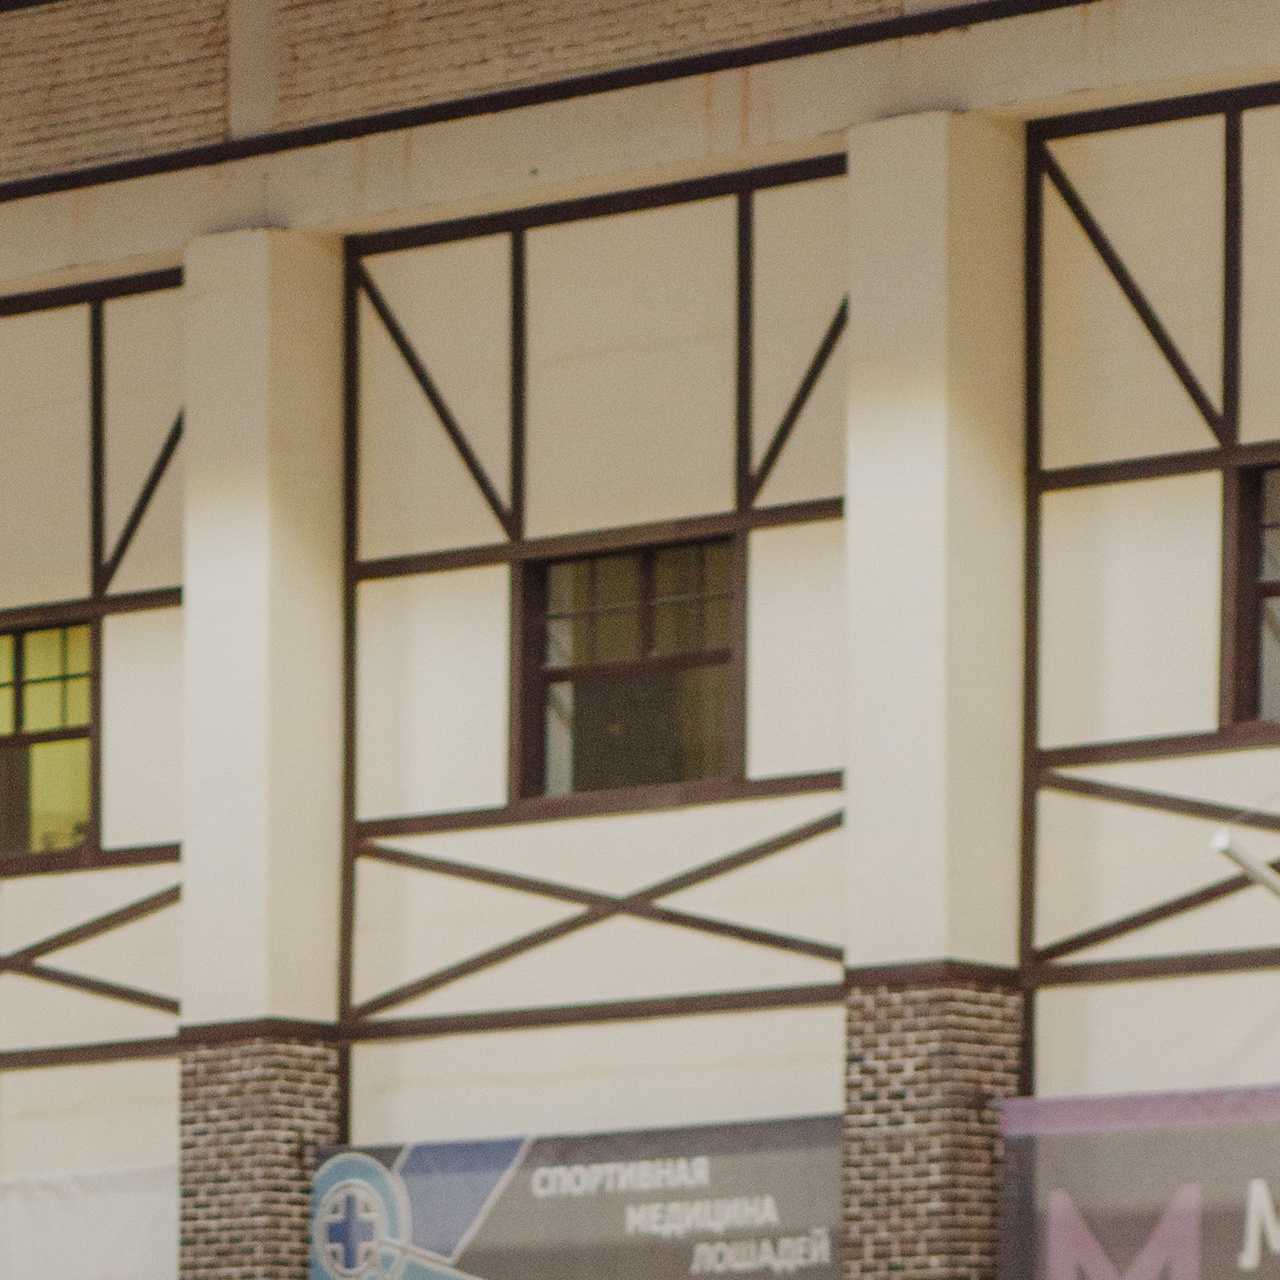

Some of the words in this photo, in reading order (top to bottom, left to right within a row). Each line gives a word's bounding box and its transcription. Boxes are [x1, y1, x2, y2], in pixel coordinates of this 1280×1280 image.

[531, 1156, 710, 1199] СПОРТИВНАЯ
[625, 1196, 779, 1237] МЕДИЦИНА
[690, 1227, 832, 1275] ЛОШАДЕЙ
